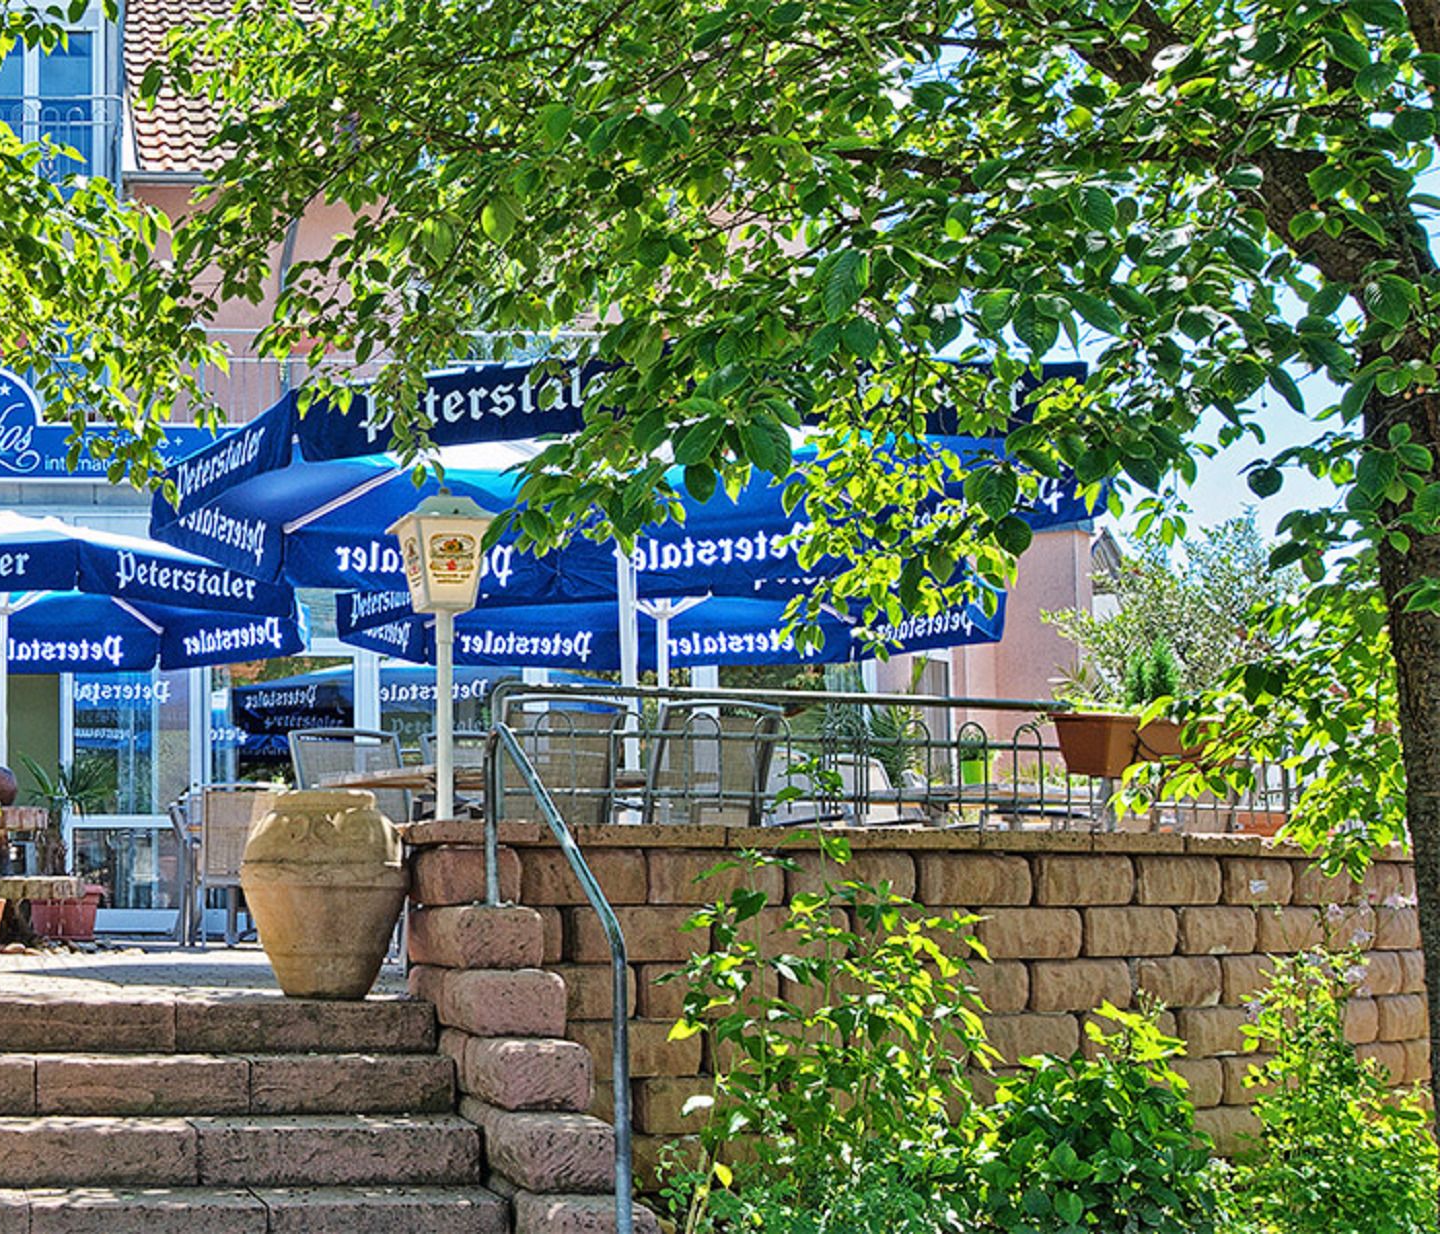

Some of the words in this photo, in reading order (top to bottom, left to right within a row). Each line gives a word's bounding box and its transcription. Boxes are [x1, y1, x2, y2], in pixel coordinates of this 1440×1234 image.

[359, 365, 618, 443] Pterstal
[177, 426, 266, 503] Peterstaler
[116, 550, 257, 600] Peterstaler
